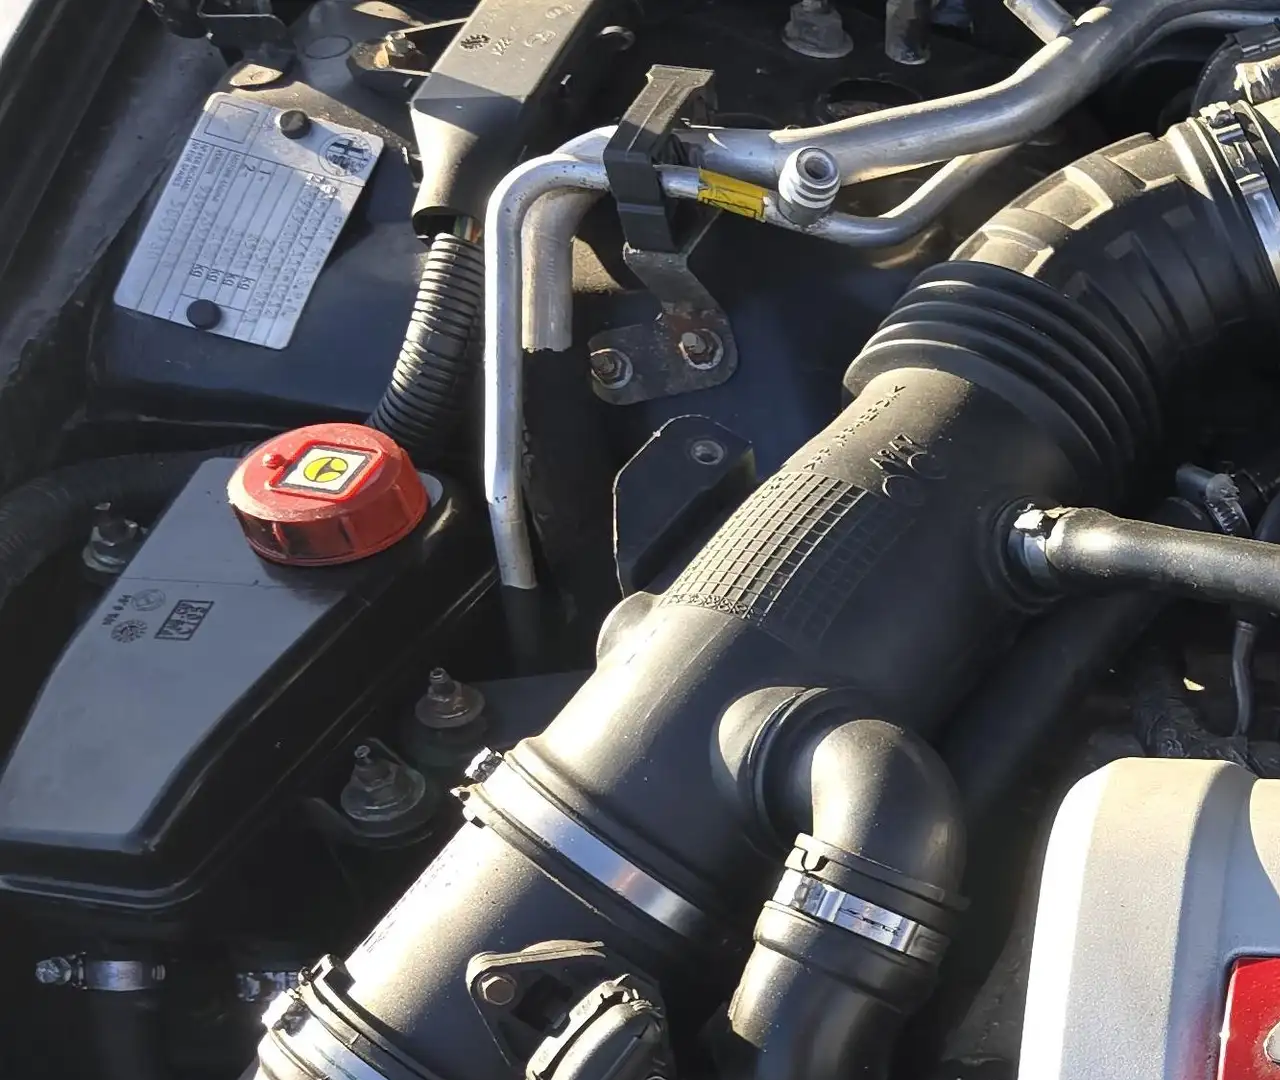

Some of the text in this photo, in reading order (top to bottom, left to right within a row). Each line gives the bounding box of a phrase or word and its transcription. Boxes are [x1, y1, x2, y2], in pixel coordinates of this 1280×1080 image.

[188, 263, 210, 279] kg
[205, 268, 223, 282] kg
[221, 272, 239, 287] kg
[237, 276, 255, 291] kg
